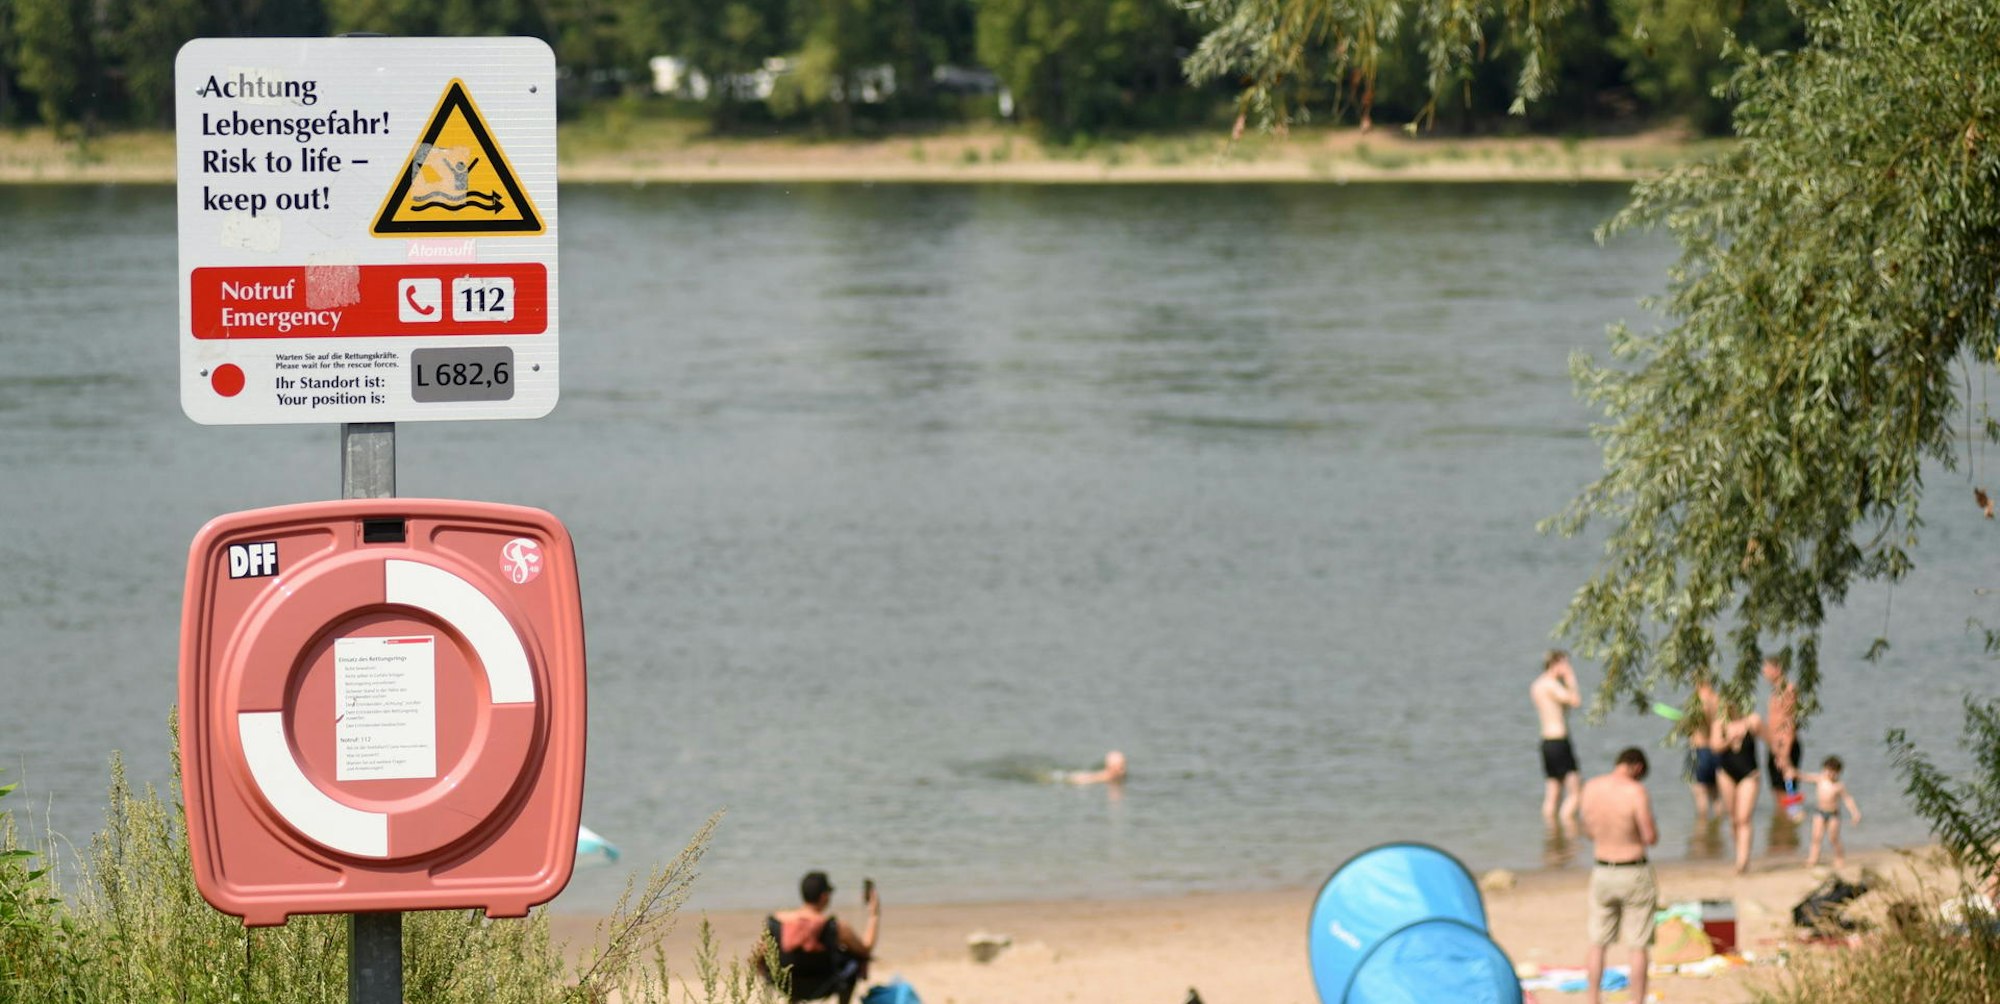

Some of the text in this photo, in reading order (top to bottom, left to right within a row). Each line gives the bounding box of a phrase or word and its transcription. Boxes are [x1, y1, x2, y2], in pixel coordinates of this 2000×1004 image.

[203, 73, 317, 105] Achtung
[203, 110, 390, 143] Lebensgefahr!
[203, 148, 257, 173] Risk
[265, 151, 292, 173] to
[301, 147, 341, 172] life
[203, 186, 330, 218] keep out!
[221, 279, 296, 300] Notruf
[461, 287, 505, 312] 112
[221, 308, 342, 332] Emergency
[276, 353, 303, 361] Warten
[345, 352, 399, 361] Rettungskräfte.
[320, 361, 331, 369] for
[276, 375, 385, 389] Ihr Standort ist:
[417, 362, 509, 388] L 682,6
[277, 392, 385, 409] Your position is:
[230, 543, 276, 577] DFF
